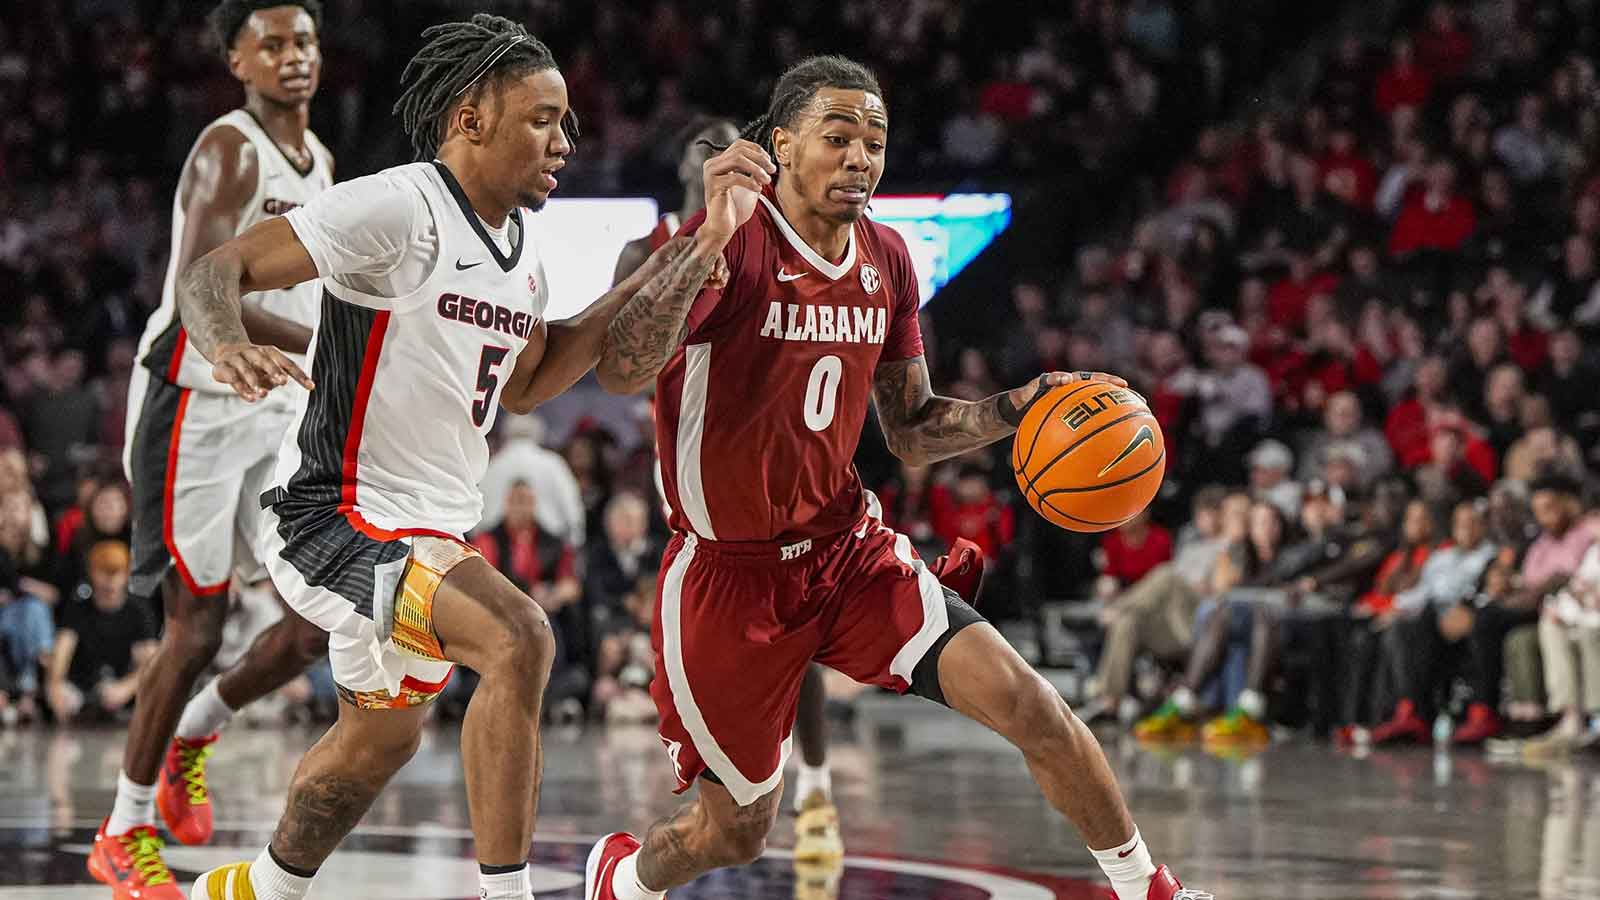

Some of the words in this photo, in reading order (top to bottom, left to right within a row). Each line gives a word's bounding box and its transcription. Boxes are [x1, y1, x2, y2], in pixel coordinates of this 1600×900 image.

[437, 292, 539, 341] GEORGI
[760, 301, 887, 344] ALABAMA
[471, 343, 511, 428] 5
[803, 355, 843, 432] 0
